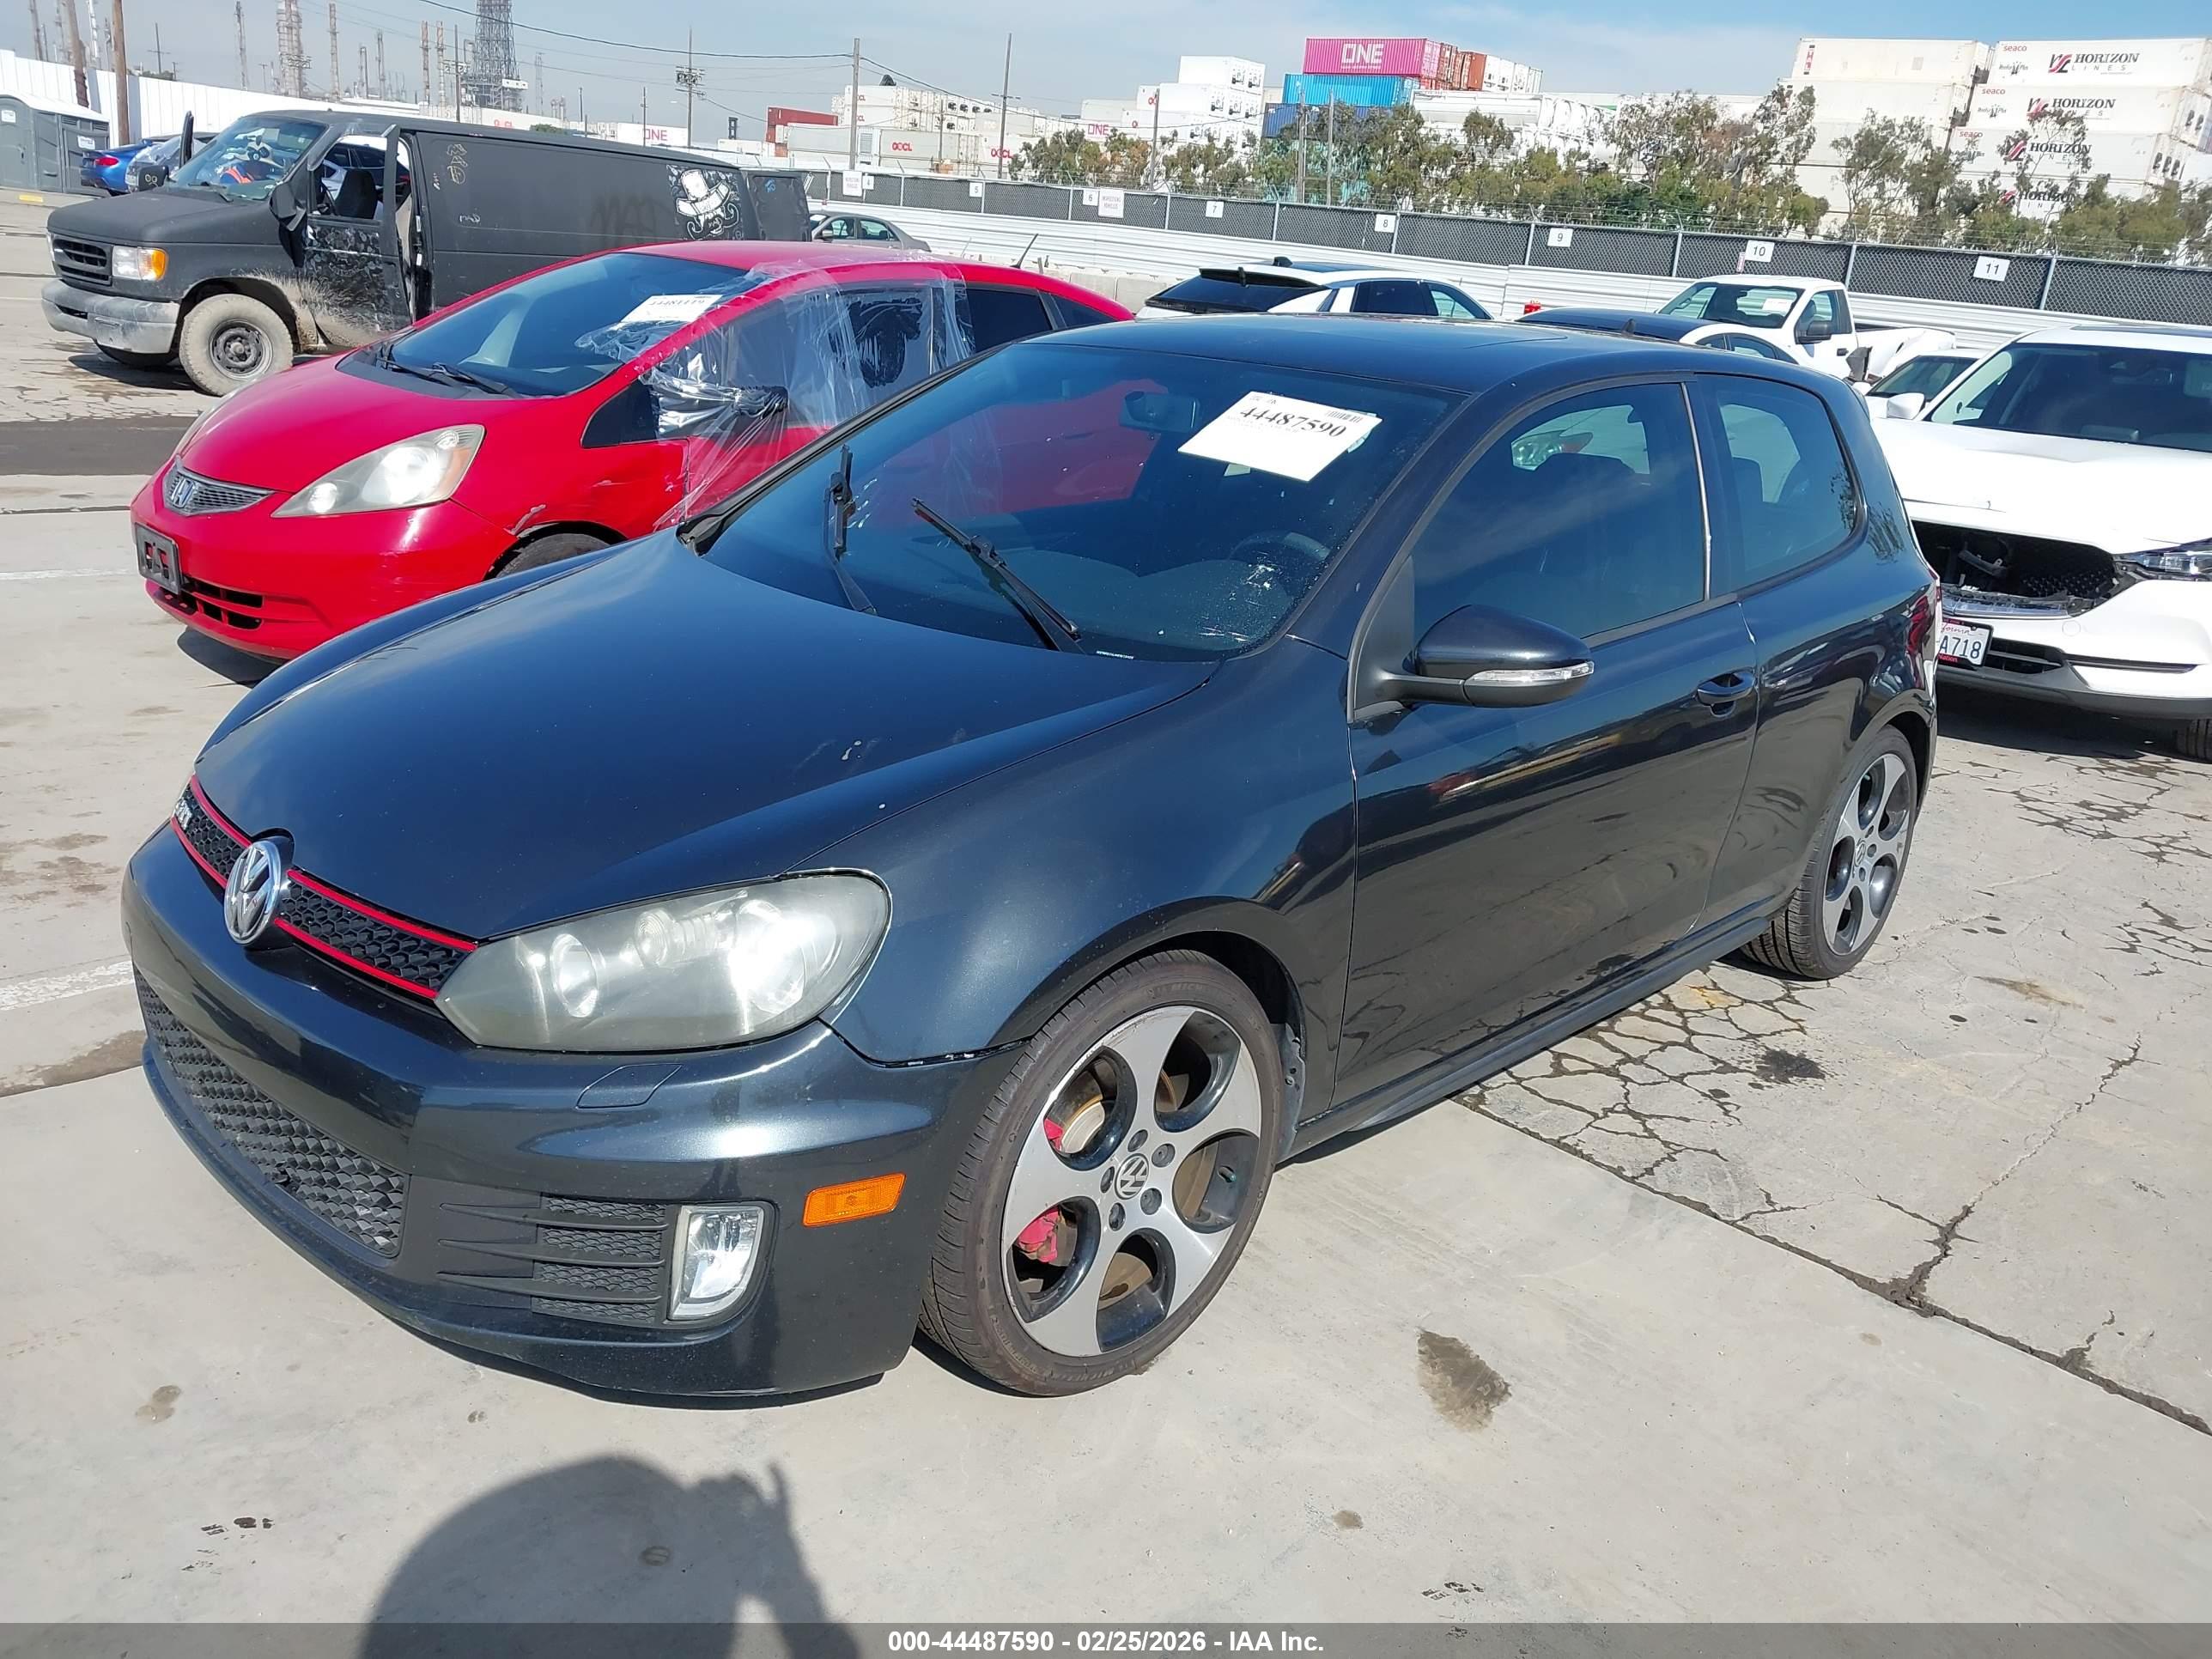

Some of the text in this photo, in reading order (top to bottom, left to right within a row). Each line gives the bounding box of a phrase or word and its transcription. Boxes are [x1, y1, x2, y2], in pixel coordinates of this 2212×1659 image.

[1341, 44, 1384, 64] ONE
[2074, 53, 2140, 64] HORIZON
[2052, 98, 2117, 108] HORIZON
[642, 128, 667, 141] ONE
[1088, 124, 1109, 136] ONE
[2029, 143, 2092, 154] HORIZON
[1088, 193, 1093, 202] 6
[1212, 205, 1218, 214] 7
[1382, 219, 1389, 228] 8
[1557, 233, 1564, 242] 9
[1753, 246, 1766, 257] 10
[1985, 263, 1999, 275] 11
[1240, 407, 1346, 437] 44487590
[1939, 635, 1982, 659] A718
